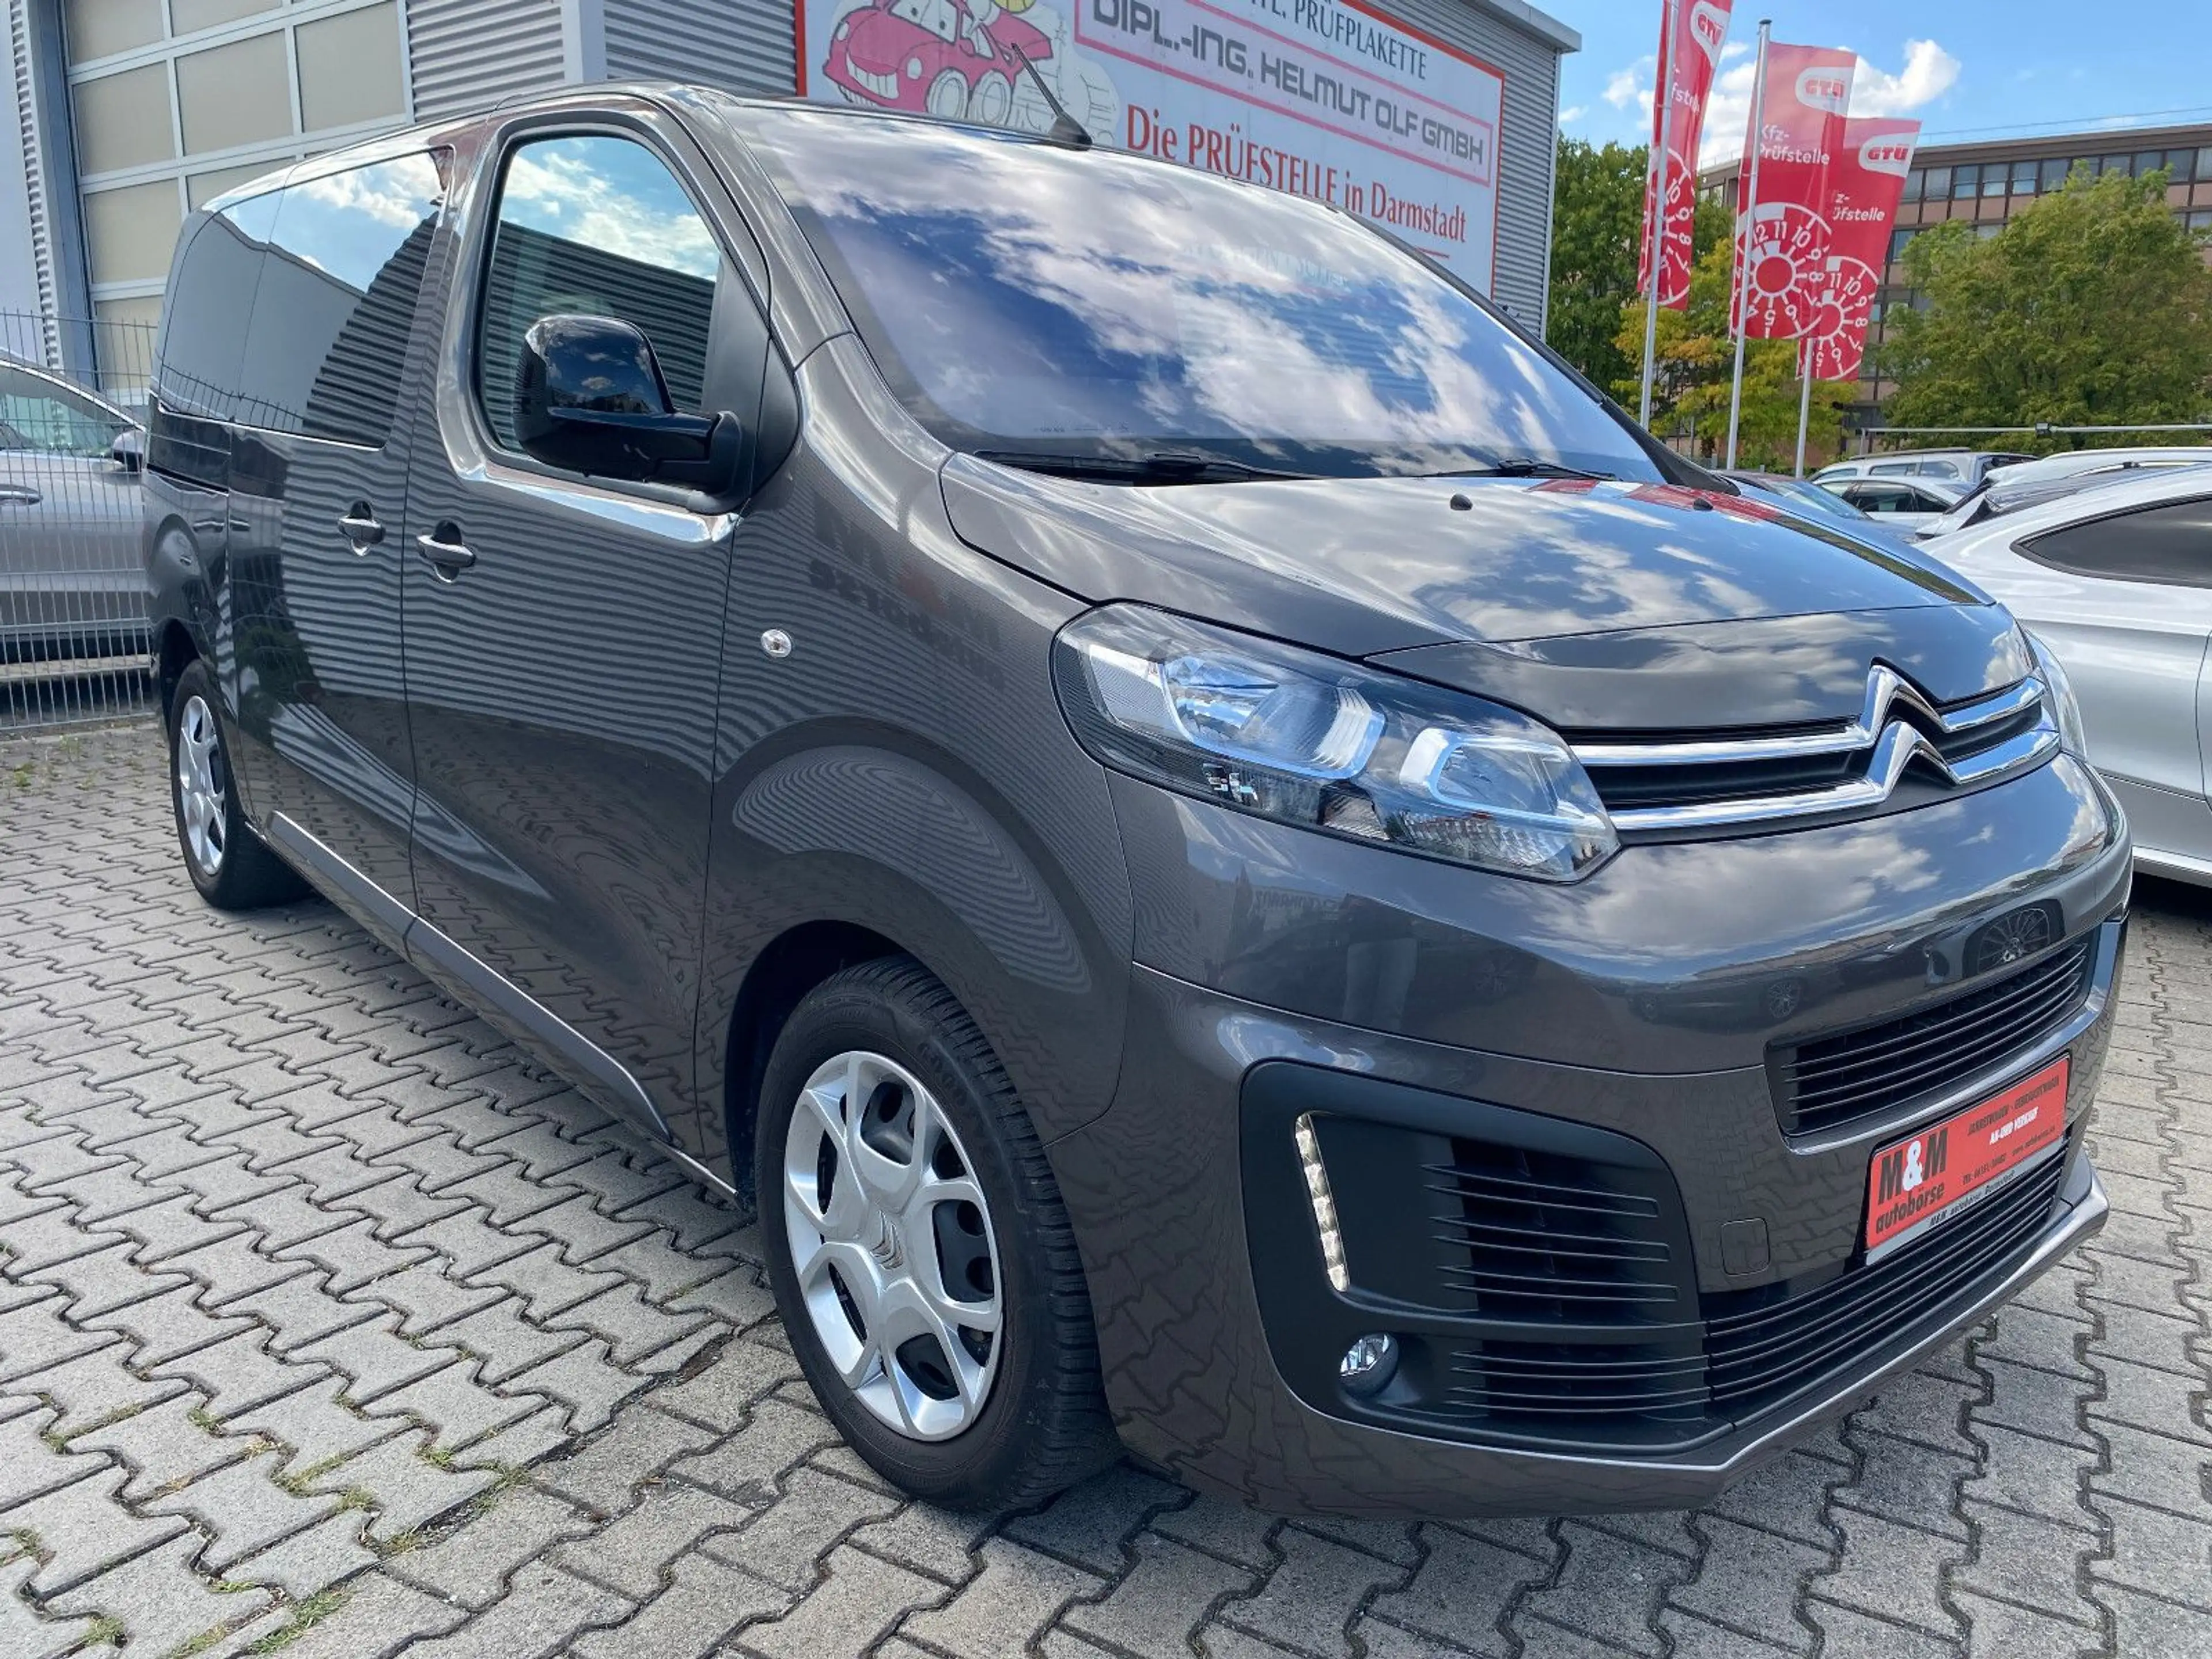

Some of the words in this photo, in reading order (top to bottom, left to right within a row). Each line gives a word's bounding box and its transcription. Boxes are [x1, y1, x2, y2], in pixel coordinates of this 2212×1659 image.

[1294, 0, 1426, 80] PRÜFPLAKETTE
[1260, 50, 1371, 121] HELMUT
[1375, 98, 1418, 138] OLF
[1422, 118, 1483, 165] GMBH
[1804, 79, 1846, 101] GTÜ
[1127, 104, 1177, 161] Die
[1188, 123, 1337, 204] PRÜFSTELLE
[1344, 171, 1363, 214] in
[1371, 180, 1466, 243] Darmstadt
[1867, 143, 1910, 161] GTÜ
[1774, 221, 1787, 240] 11
[1791, 224, 1812, 248] 10
[1809, 271, 1825, 283] 8
[1830, 272, 1842, 288] 11
[1843, 276, 1861, 296] 10
[1854, 317, 1869, 328] 8
[1878, 1127, 1949, 1205] M&M
[1876, 1182, 1945, 1234] autobörse
